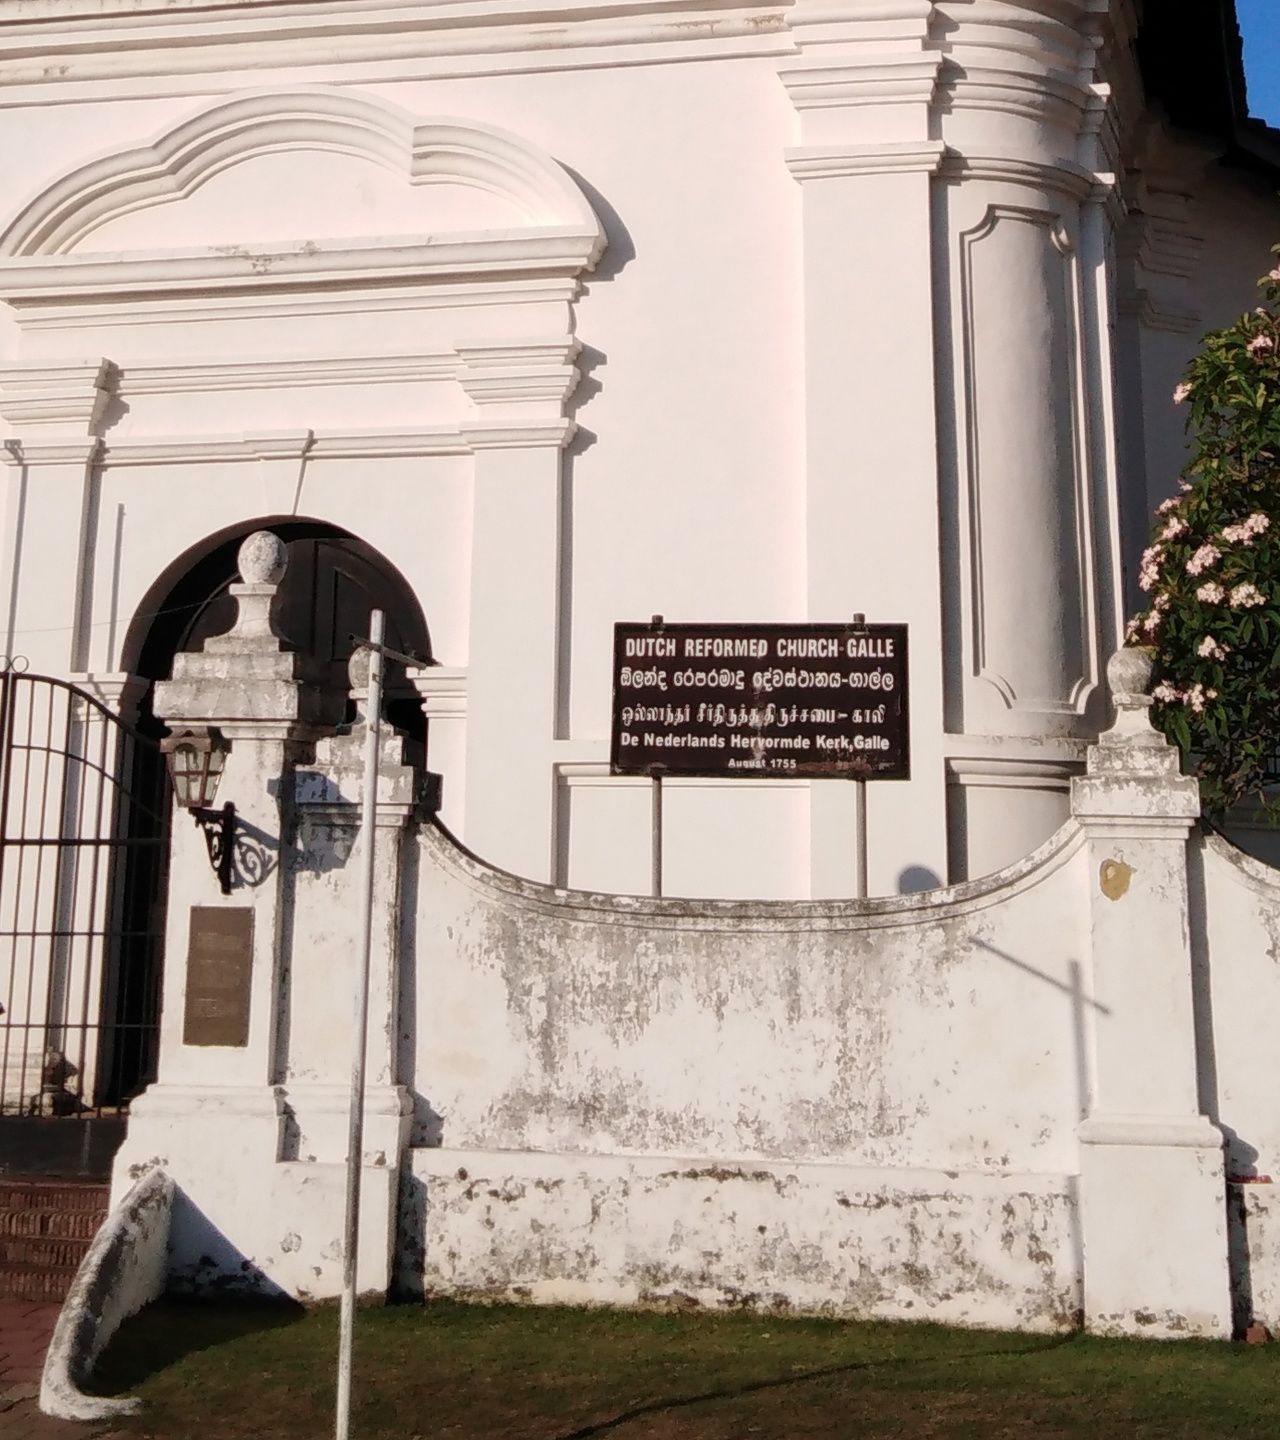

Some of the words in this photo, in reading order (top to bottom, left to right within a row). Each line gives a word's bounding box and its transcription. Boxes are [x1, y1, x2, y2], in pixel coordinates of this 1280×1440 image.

[625, 638, 676, 657] DUTCH
[684, 638, 768, 658] REFORMED
[620, 732, 639, 747] De
[644, 732, 726, 748] Nederlands
[730, 733, 811, 749] Hervormde
[728, 757, 767, 769] August
[770, 758, 797, 769] 1755
